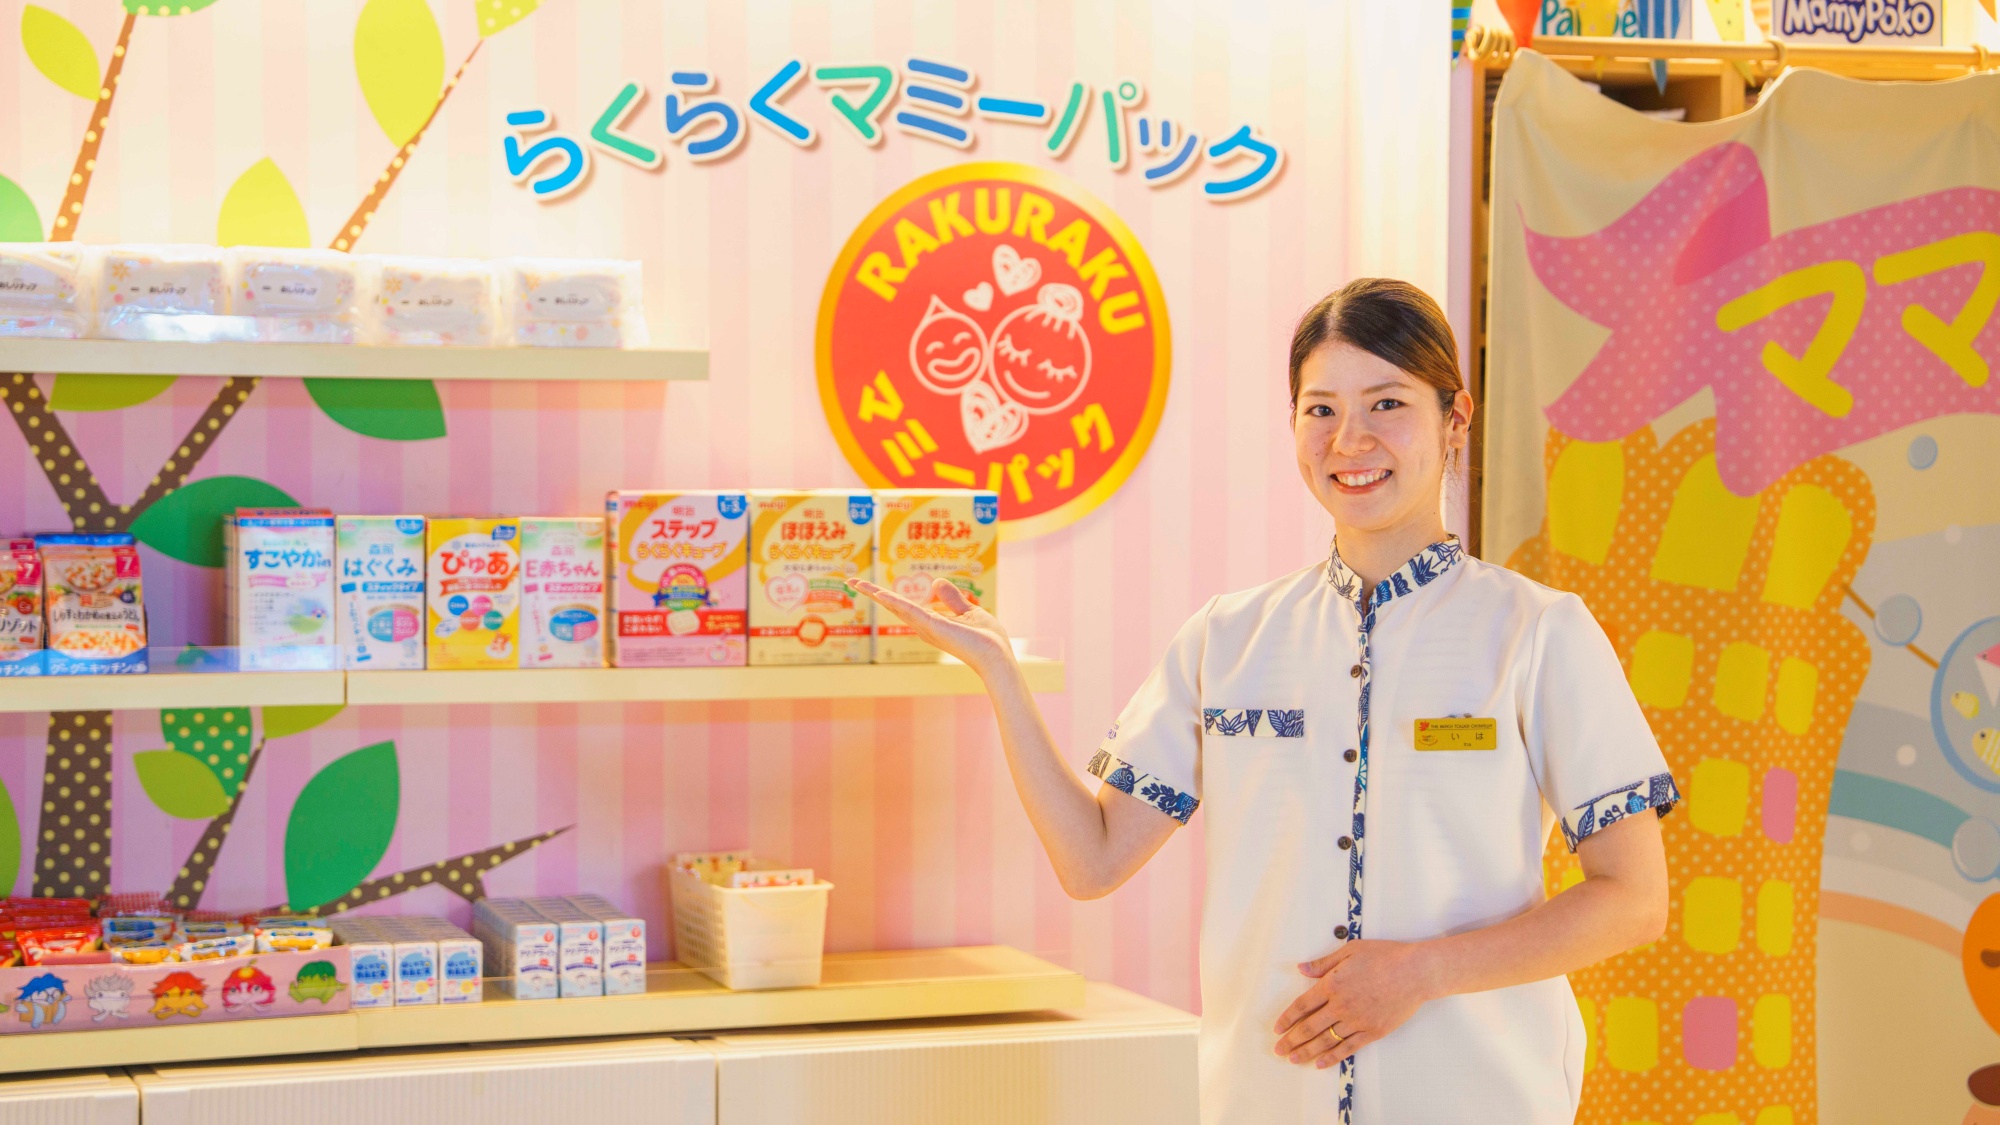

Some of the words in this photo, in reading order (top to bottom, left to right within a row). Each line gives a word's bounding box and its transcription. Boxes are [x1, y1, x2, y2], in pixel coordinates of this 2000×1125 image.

[1782, 0, 1935, 43] MamyPoko
[502, 57, 1282, 197] らくらくマミーパック
[855, 186, 1147, 335] RAKURAKU
[857, 368, 1115, 504] マミーパック
[650, 519, 718, 539] ステップ
[781, 521, 847, 541] ほほえみ
[907, 521, 971, 541] ほほえみ
[244, 548, 322, 570] すこやか
[637, 541, 729, 560] らくらくキューブ
[769, 543, 856, 561] らくらくキューブ
[896, 543, 981, 560] らくらくキューブ
[23, 562, 36, 579] 7
[121, 556, 134, 573] 7
[343, 558, 418, 577] はぐくみ
[440, 550, 509, 576] ぴゅあ
[525, 559, 600, 578] E赤ちゃん
[1451, 732, 1460, 741] い
